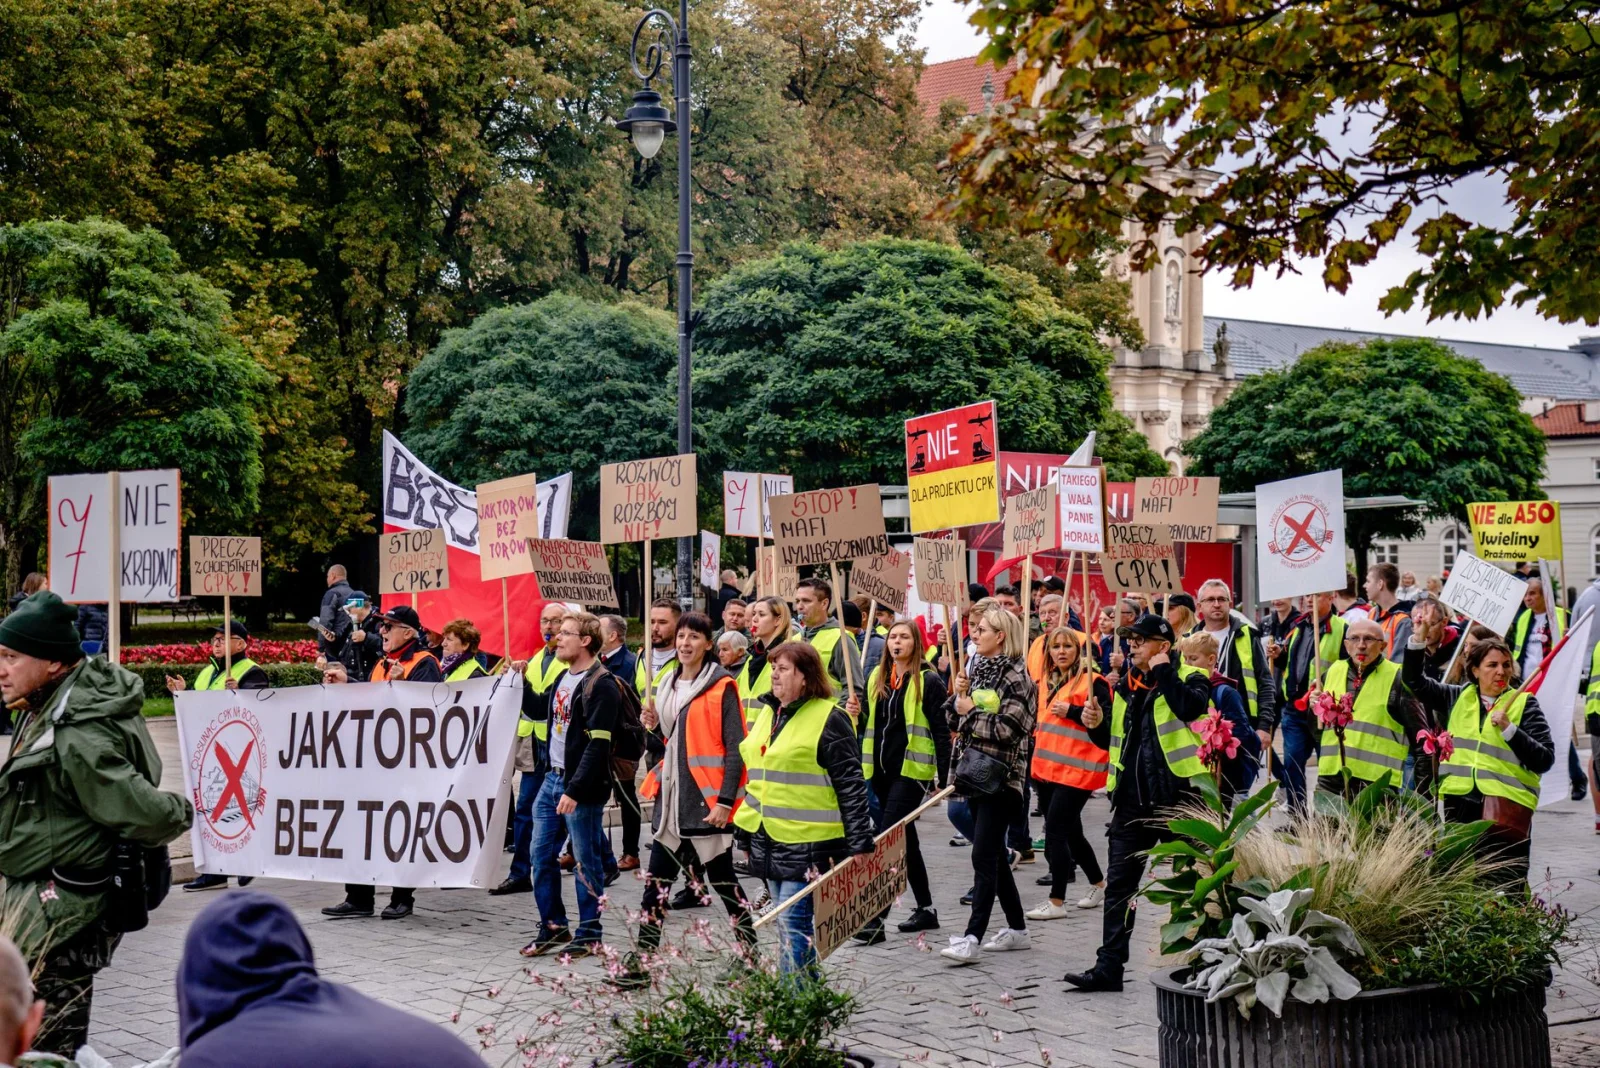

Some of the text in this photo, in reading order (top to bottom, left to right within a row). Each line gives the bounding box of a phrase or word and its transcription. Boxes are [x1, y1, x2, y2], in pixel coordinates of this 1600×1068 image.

[927, 423, 959, 464] NIE
[616, 457, 681, 487] ROZWÓJ
[1061, 474, 1098, 488] TAKIEGO
[625, 483, 662, 502] TAK
[764, 480, 789, 503] NIE
[911, 475, 994, 504] DLA PROJEKTU CPK
[1150, 477, 1199, 497] STOP!
[125, 484, 171, 527] NIE
[791, 487, 858, 518] STOP!
[1068, 493, 1094, 506] WAŁA
[1141, 497, 1172, 513] MAFI
[614, 497, 677, 525] ROZBÓJ
[1019, 508, 1039, 525] TAK
[1068, 511, 1094, 525] PANIE
[1497, 513, 1513, 525] dla
[1513, 502, 1556, 525] A50
[497, 519, 517, 539] BEZ
[625, 518, 661, 542] NIE!
[781, 516, 826, 539] MAFI
[1064, 531, 1100, 546] HORAŁA
[1108, 525, 1157, 545] PRECZ
[200, 537, 249, 559] PRECZ
[389, 530, 433, 554] STOP
[916, 541, 932, 561] NIE
[1478, 531, 1540, 549] Uwieliny
[540, 553, 563, 571] POD
[868, 556, 883, 572] DO
[1484, 549, 1527, 560] Prażmów
[204, 572, 252, 594] CPK!
[393, 568, 444, 592] CPK!
[927, 562, 946, 584] SIĘ
[1115, 559, 1173, 591] CPK!
[1460, 555, 1517, 601] ZOSTAWCIE
[1447, 582, 1505, 627] NASZE DOMY
[274, 798, 345, 859] BEZ
